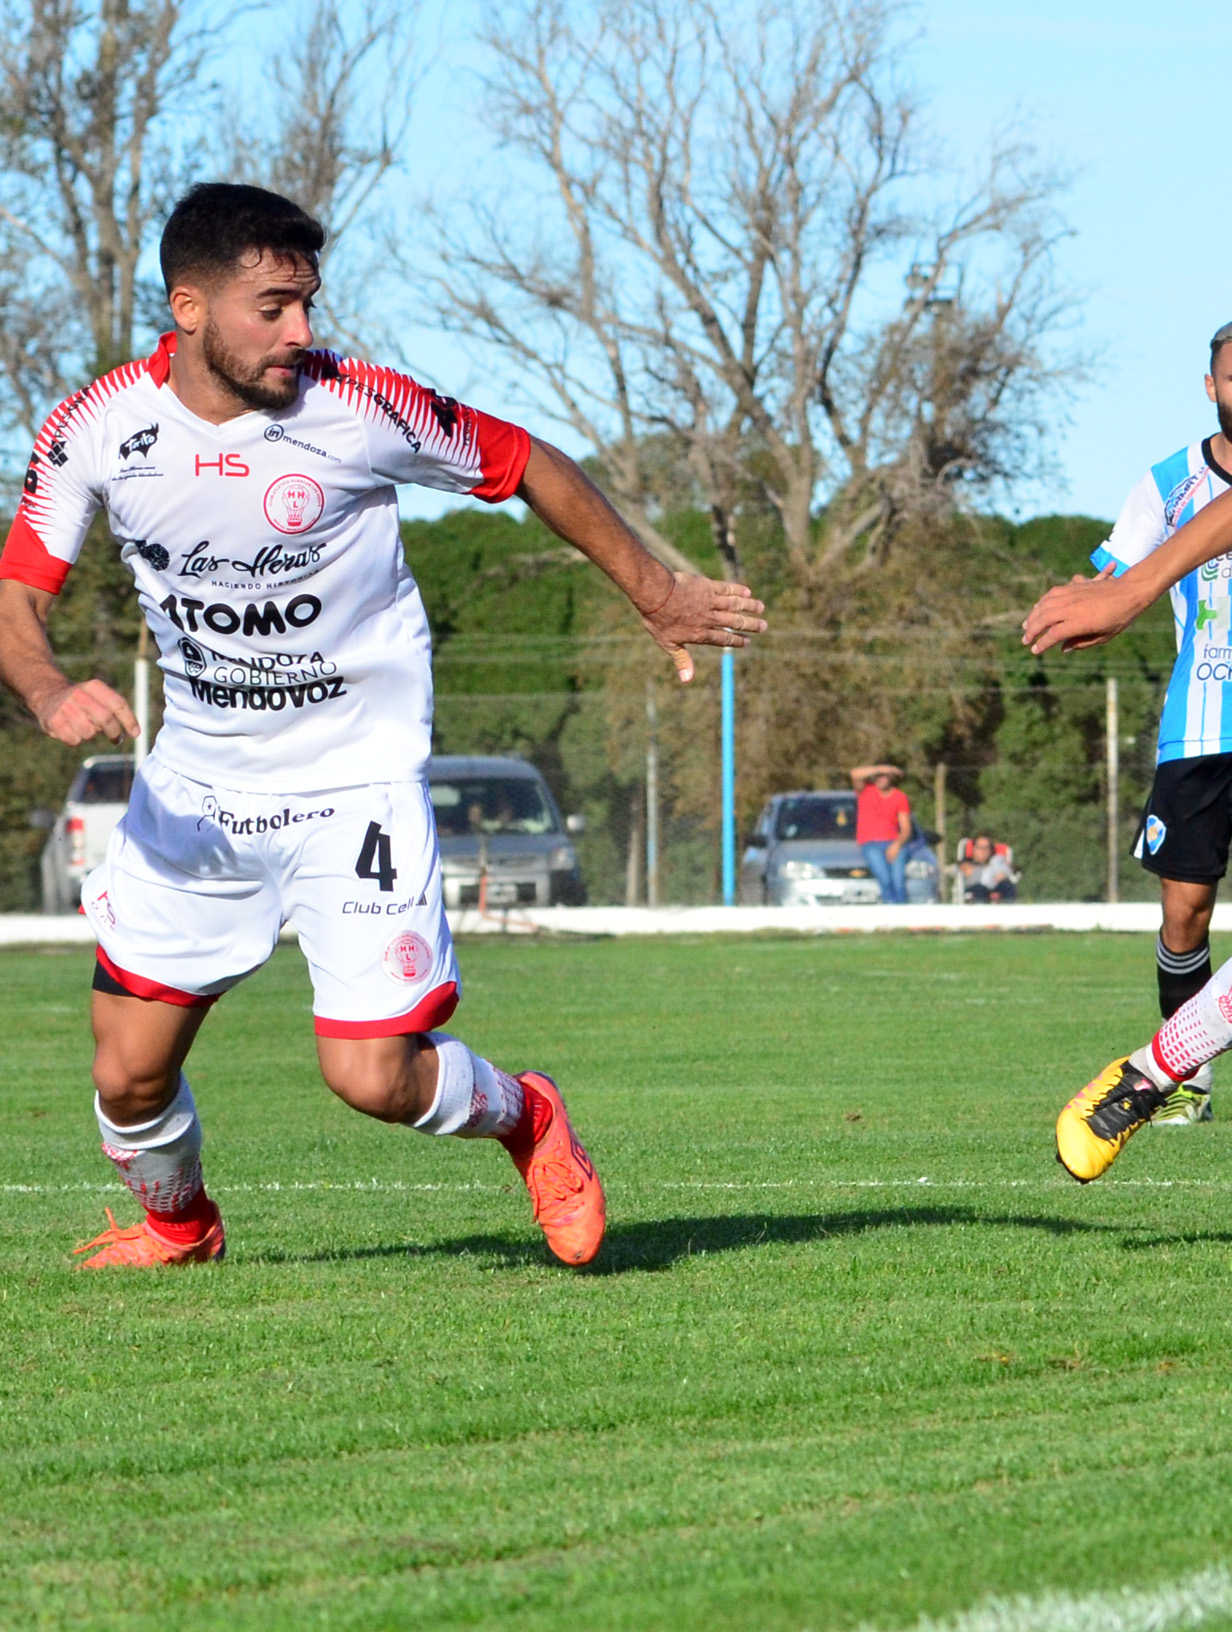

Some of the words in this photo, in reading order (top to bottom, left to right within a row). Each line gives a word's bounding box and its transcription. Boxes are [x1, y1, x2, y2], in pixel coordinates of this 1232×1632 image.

[195, 452, 250, 477] HS
[177, 541, 230, 578] Las
[231, 542, 327, 578] Heras
[211, 580, 261, 590] HACIENDO
[160, 594, 322, 636] ATOMO
[214, 662, 337, 686] GOBIERNO
[218, 808, 335, 835] Futbolero
[355, 820, 398, 892] 4
[342, 901, 382, 915] Club
